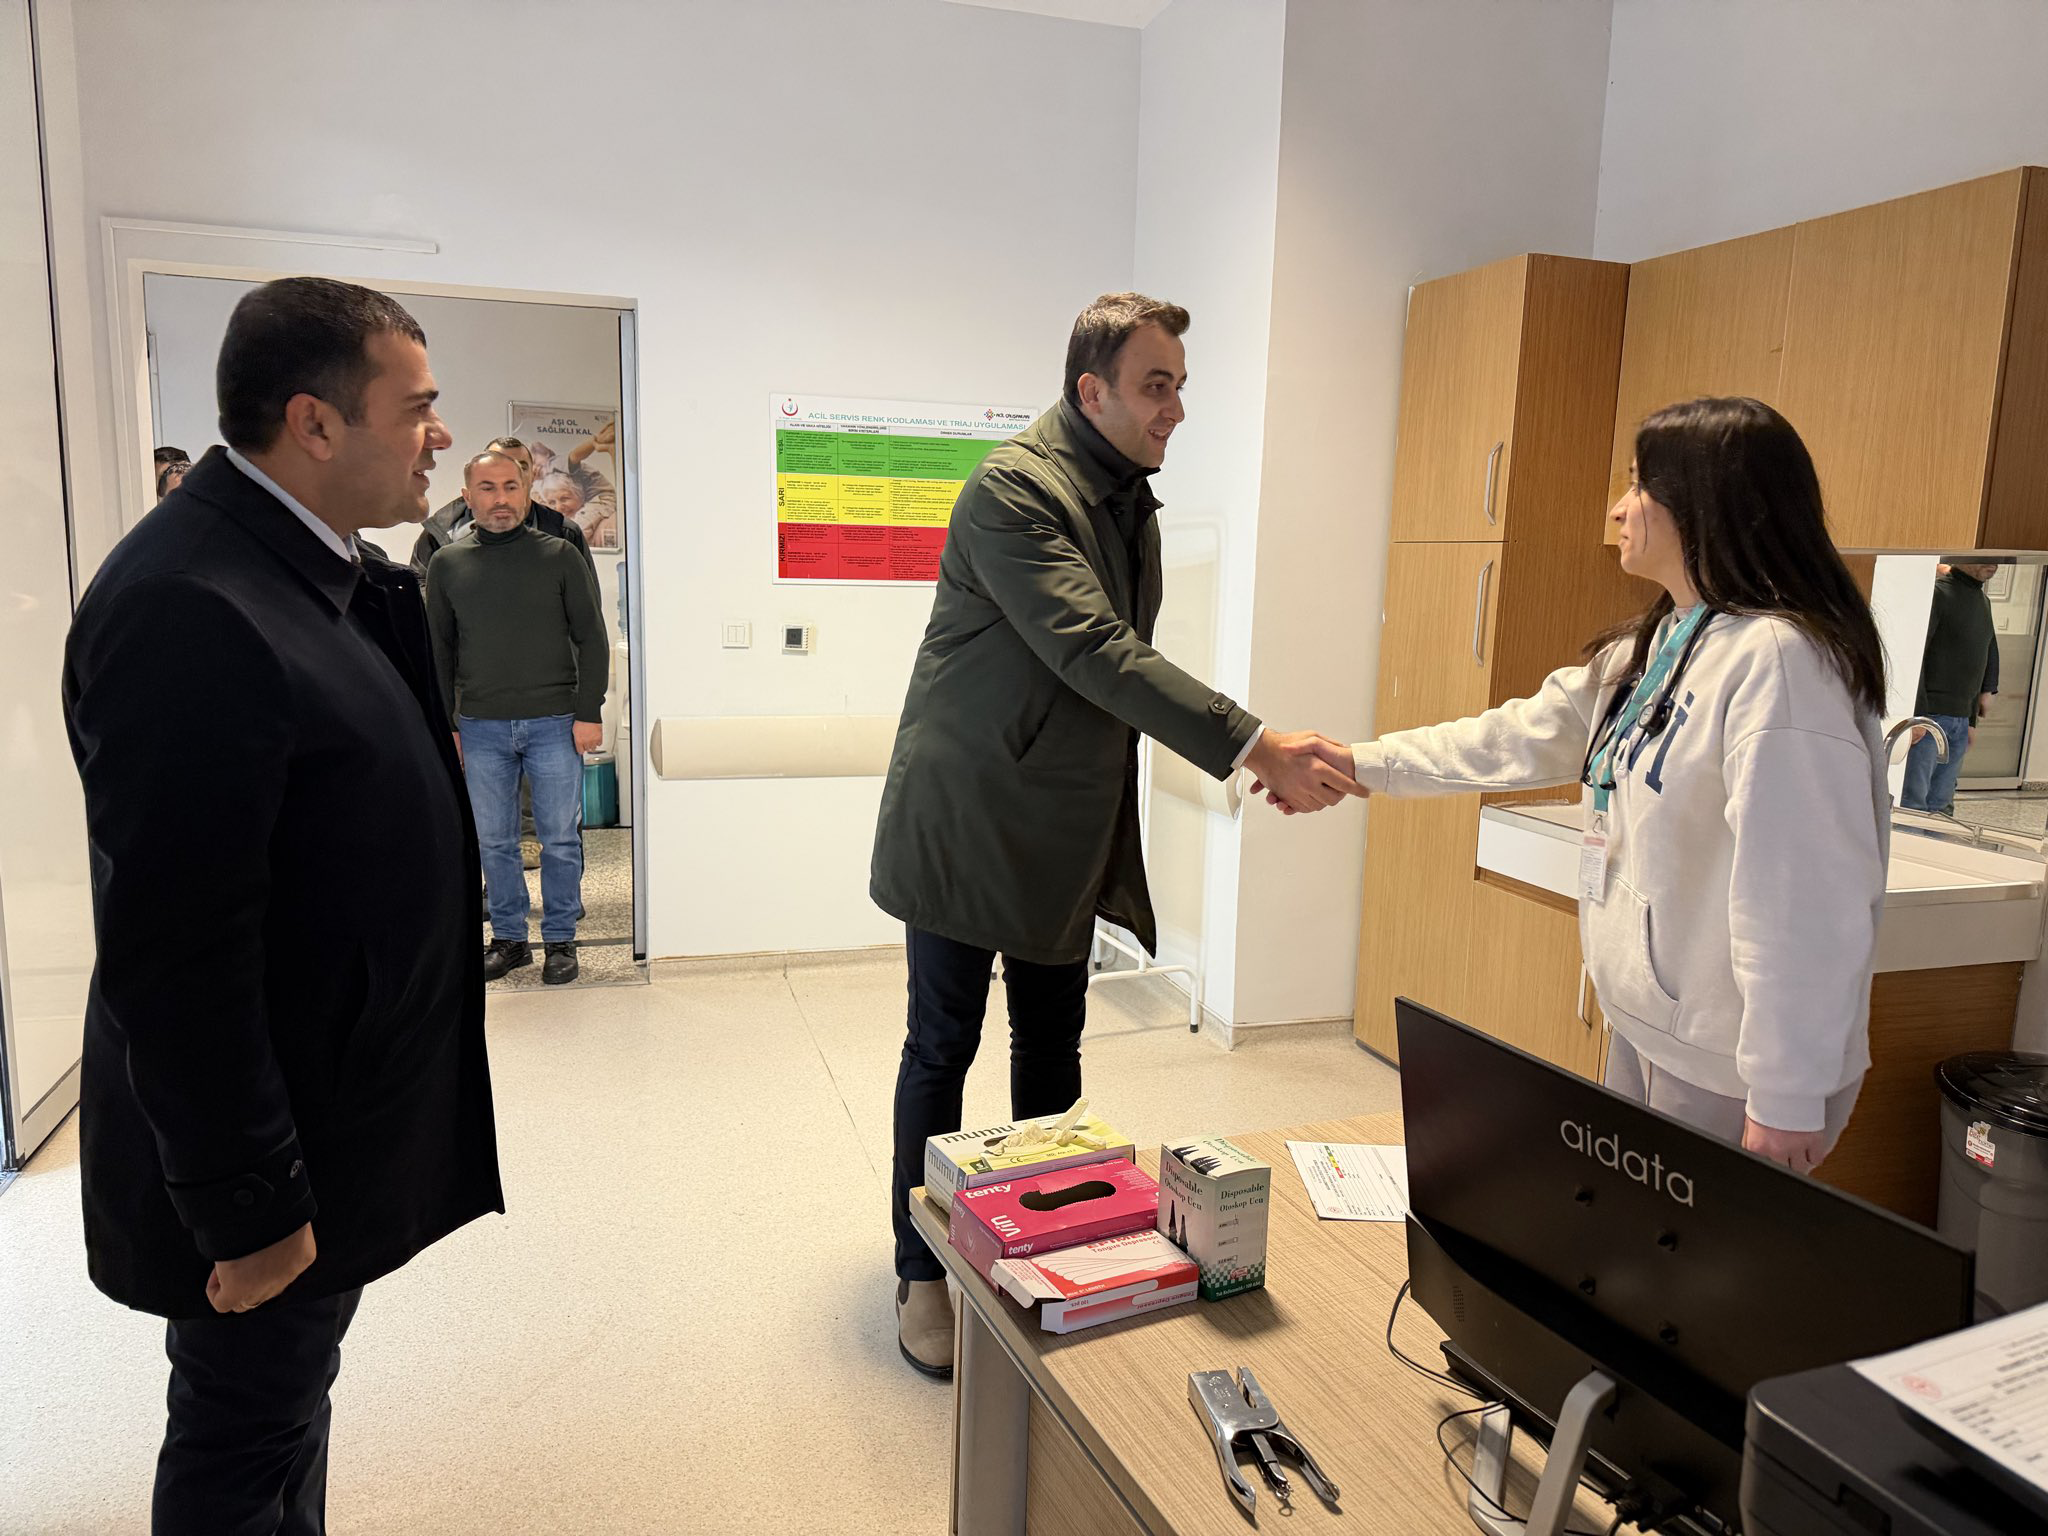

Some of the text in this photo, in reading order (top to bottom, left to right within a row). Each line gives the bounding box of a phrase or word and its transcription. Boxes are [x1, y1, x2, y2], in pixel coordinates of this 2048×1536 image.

[551, 418, 565, 427] AŞI
[808, 411, 828, 420] ACİL
[861, 415, 885, 423] RENK
[886, 416, 936, 426] KODLAMASI
[974, 420, 1026, 430] UYGULAMASI
[575, 427, 592, 435] KAL
[941, 1124, 1016, 1144] mumu
[928, 1149, 955, 1185] mumu
[1560, 1119, 1694, 1208] aidata
[1165, 1161, 1203, 1196] Disposable
[964, 1183, 1011, 1199] tenty
[1164, 1178, 1186, 1202] Otoskop
[1187, 1196, 1202, 1211] Ucu
[1220, 1183, 1265, 1200] Disposable
[1219, 1197, 1264, 1212] Otoskop Ucu
[990, 1214, 1021, 1238] vin
[1008, 1242, 1034, 1255] tenty
